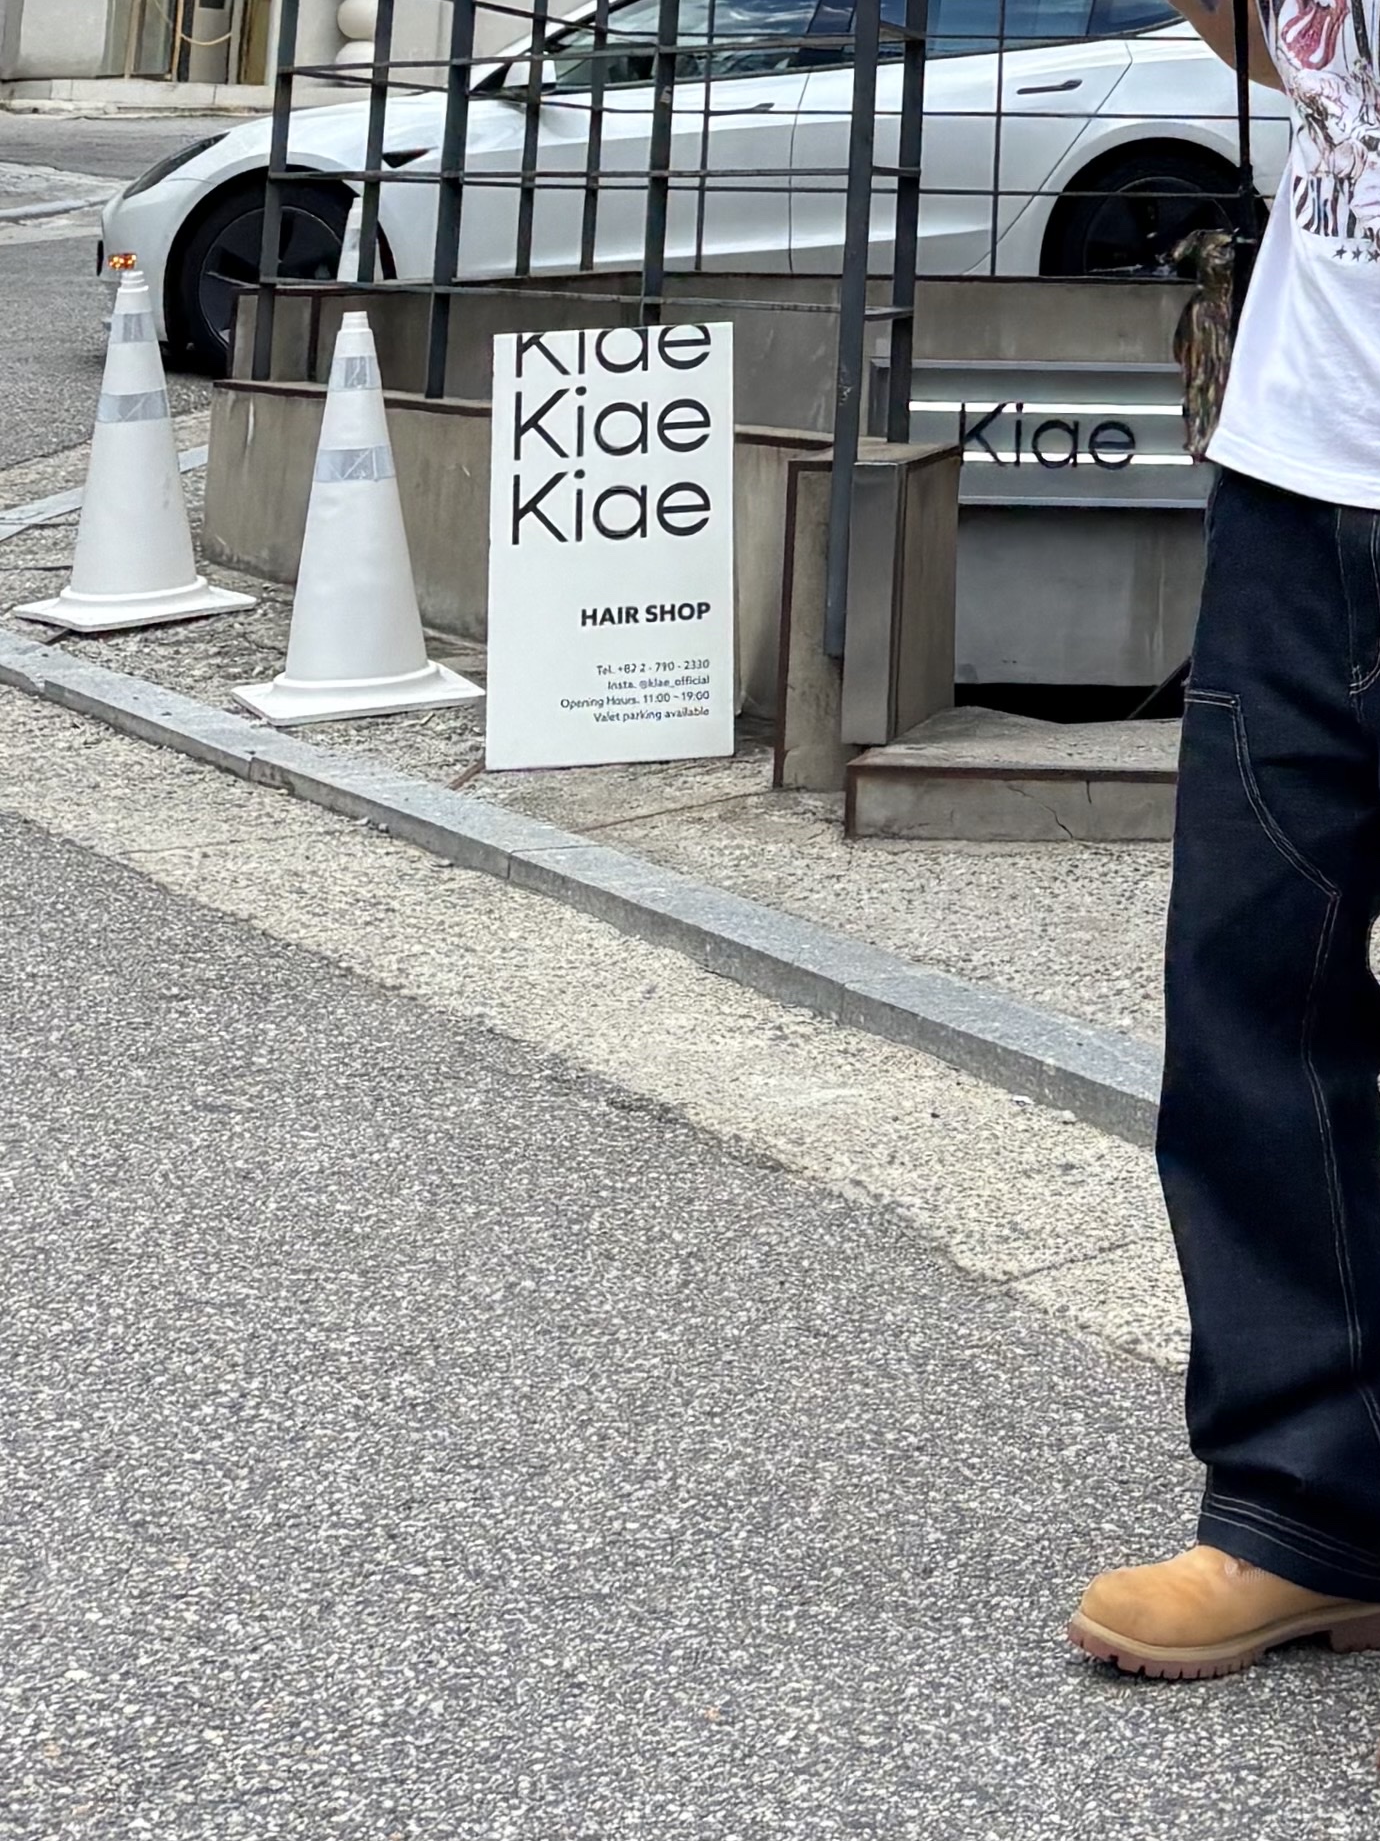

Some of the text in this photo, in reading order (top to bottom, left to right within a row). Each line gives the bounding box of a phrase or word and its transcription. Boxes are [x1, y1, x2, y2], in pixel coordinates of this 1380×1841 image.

[513, 386, 712, 461] Kiae
[960, 401, 1136, 470] Kiae
[512, 469, 711, 546] Kiae
[581, 602, 711, 627] HAIR SHOP
[560, 697, 604, 710] Opening
[593, 706, 710, 723] Valet parking available
